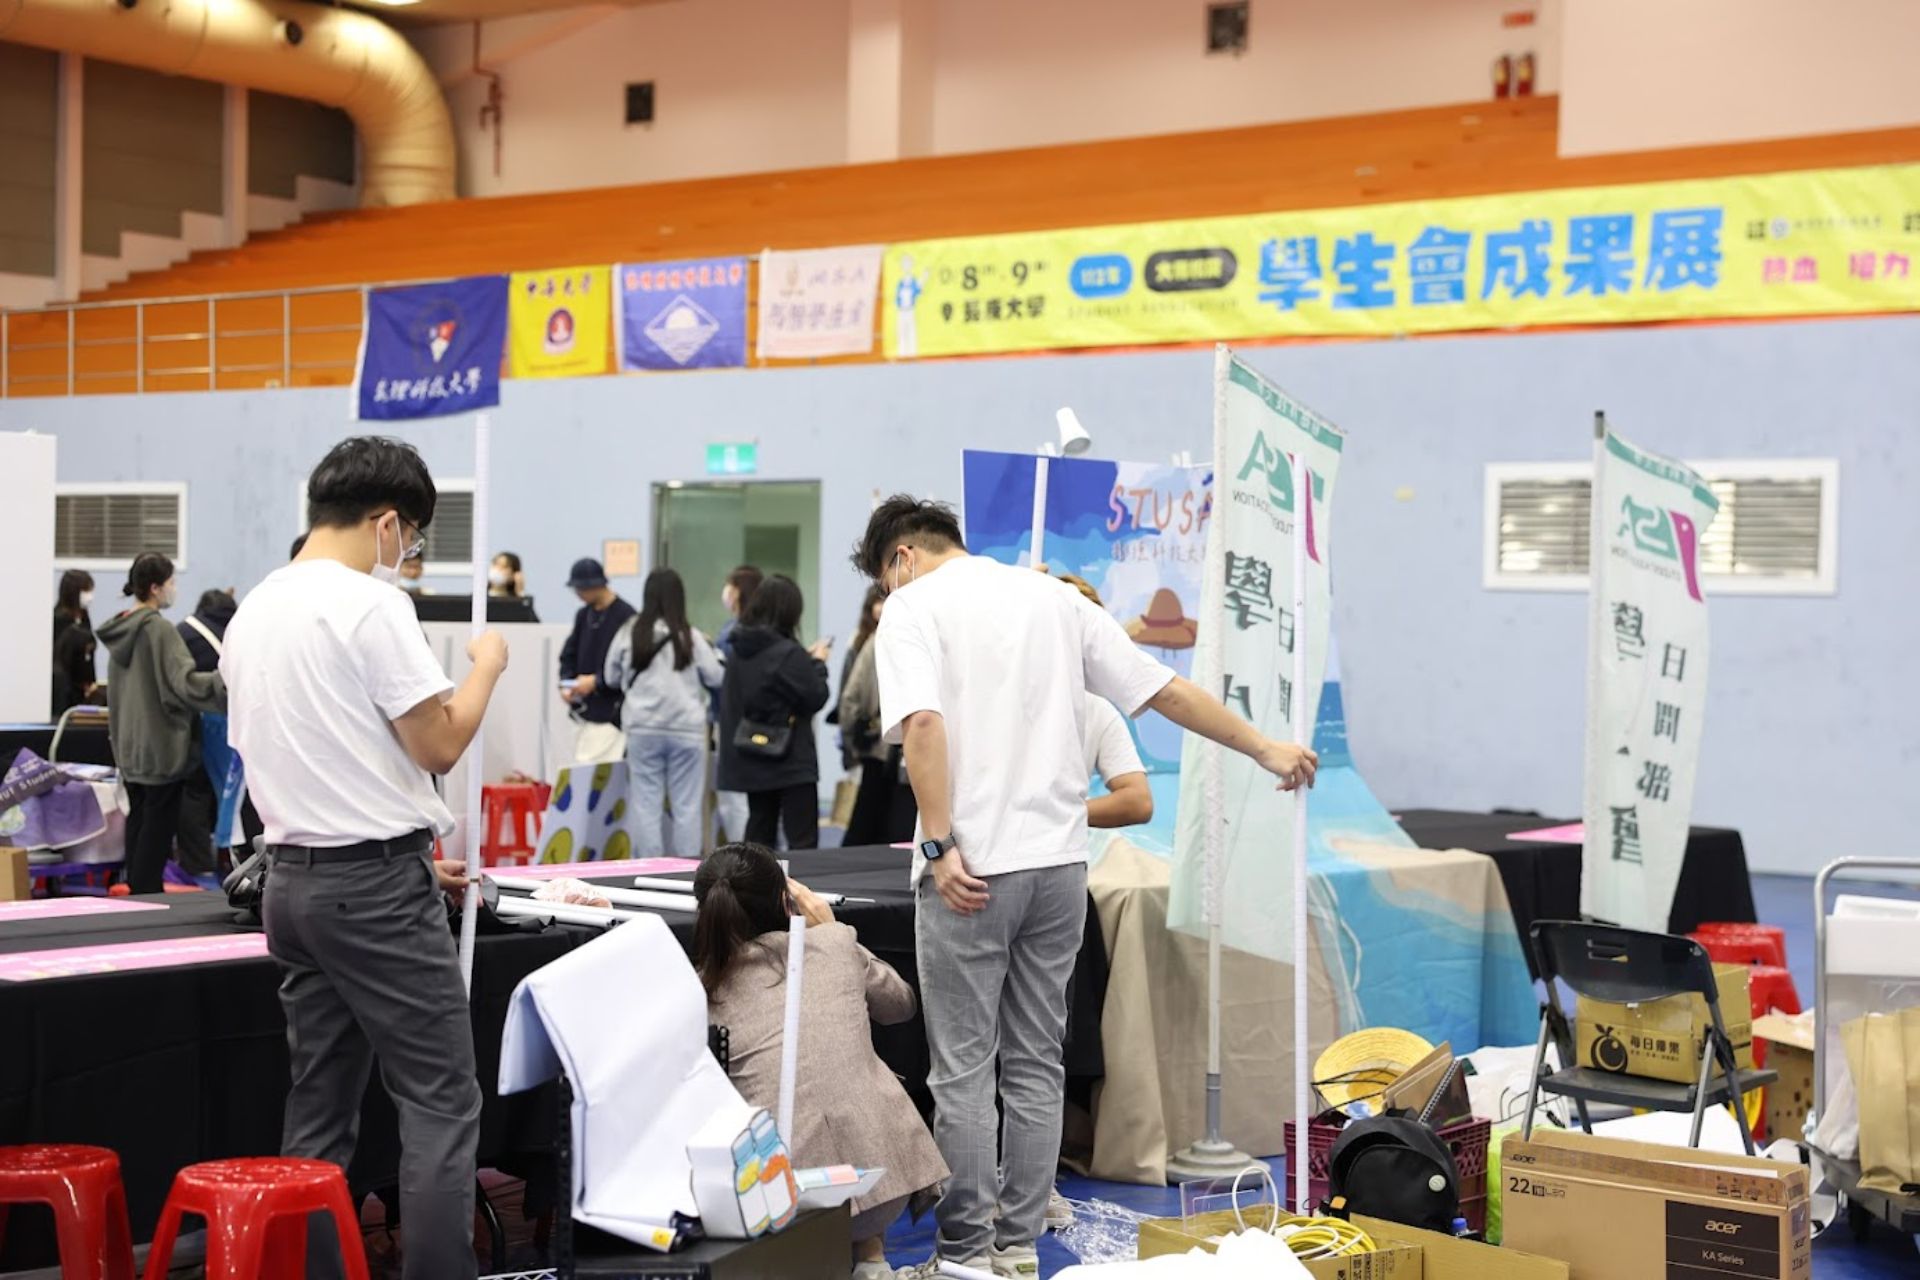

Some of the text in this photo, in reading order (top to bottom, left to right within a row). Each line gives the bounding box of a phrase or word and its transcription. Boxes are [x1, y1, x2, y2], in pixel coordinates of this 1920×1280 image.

[1258, 207, 1724, 311] 學生會成果展
[1509, 1177, 1531, 1194] 22
[1704, 1219, 1742, 1235] acer
[1702, 1249, 1745, 1266] KA Series
